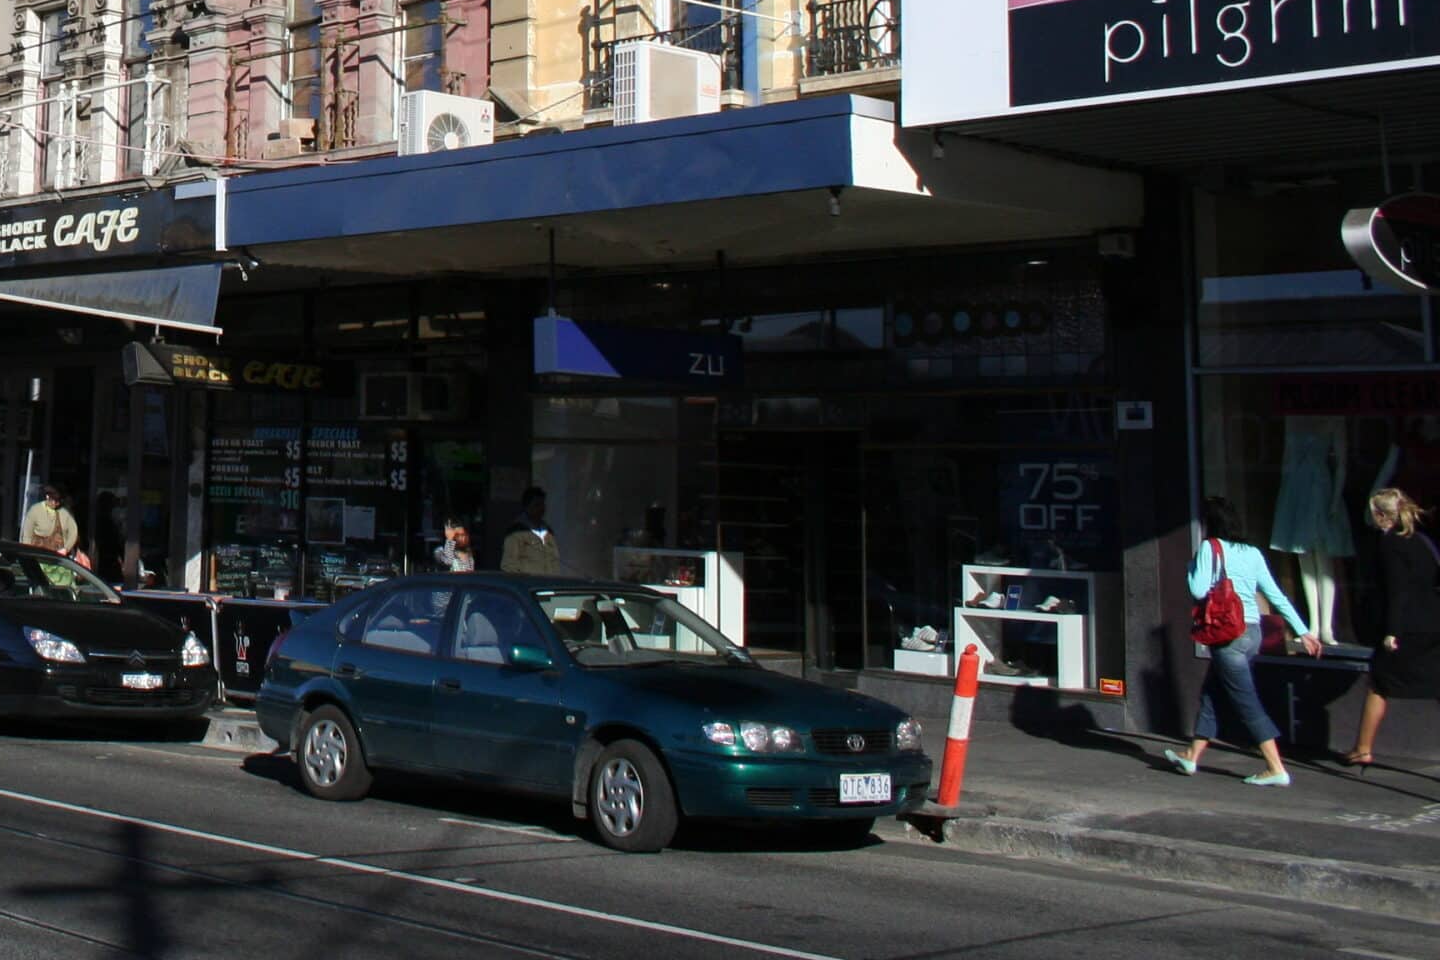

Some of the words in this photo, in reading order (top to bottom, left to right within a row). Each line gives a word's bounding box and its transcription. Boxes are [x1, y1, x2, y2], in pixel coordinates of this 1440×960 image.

[53, 206, 140, 252] CAFE
[172, 367, 233, 382] BLACK
[688, 353, 724, 376] ZU
[285, 440, 300, 461] $5
[390, 441, 408, 463] $5
[284, 466, 300, 489] $5
[390, 468, 407, 491] $5
[280, 489, 300, 510] $10
[1019, 504, 1101, 531] OFF
[870, 778, 890, 794] 836
